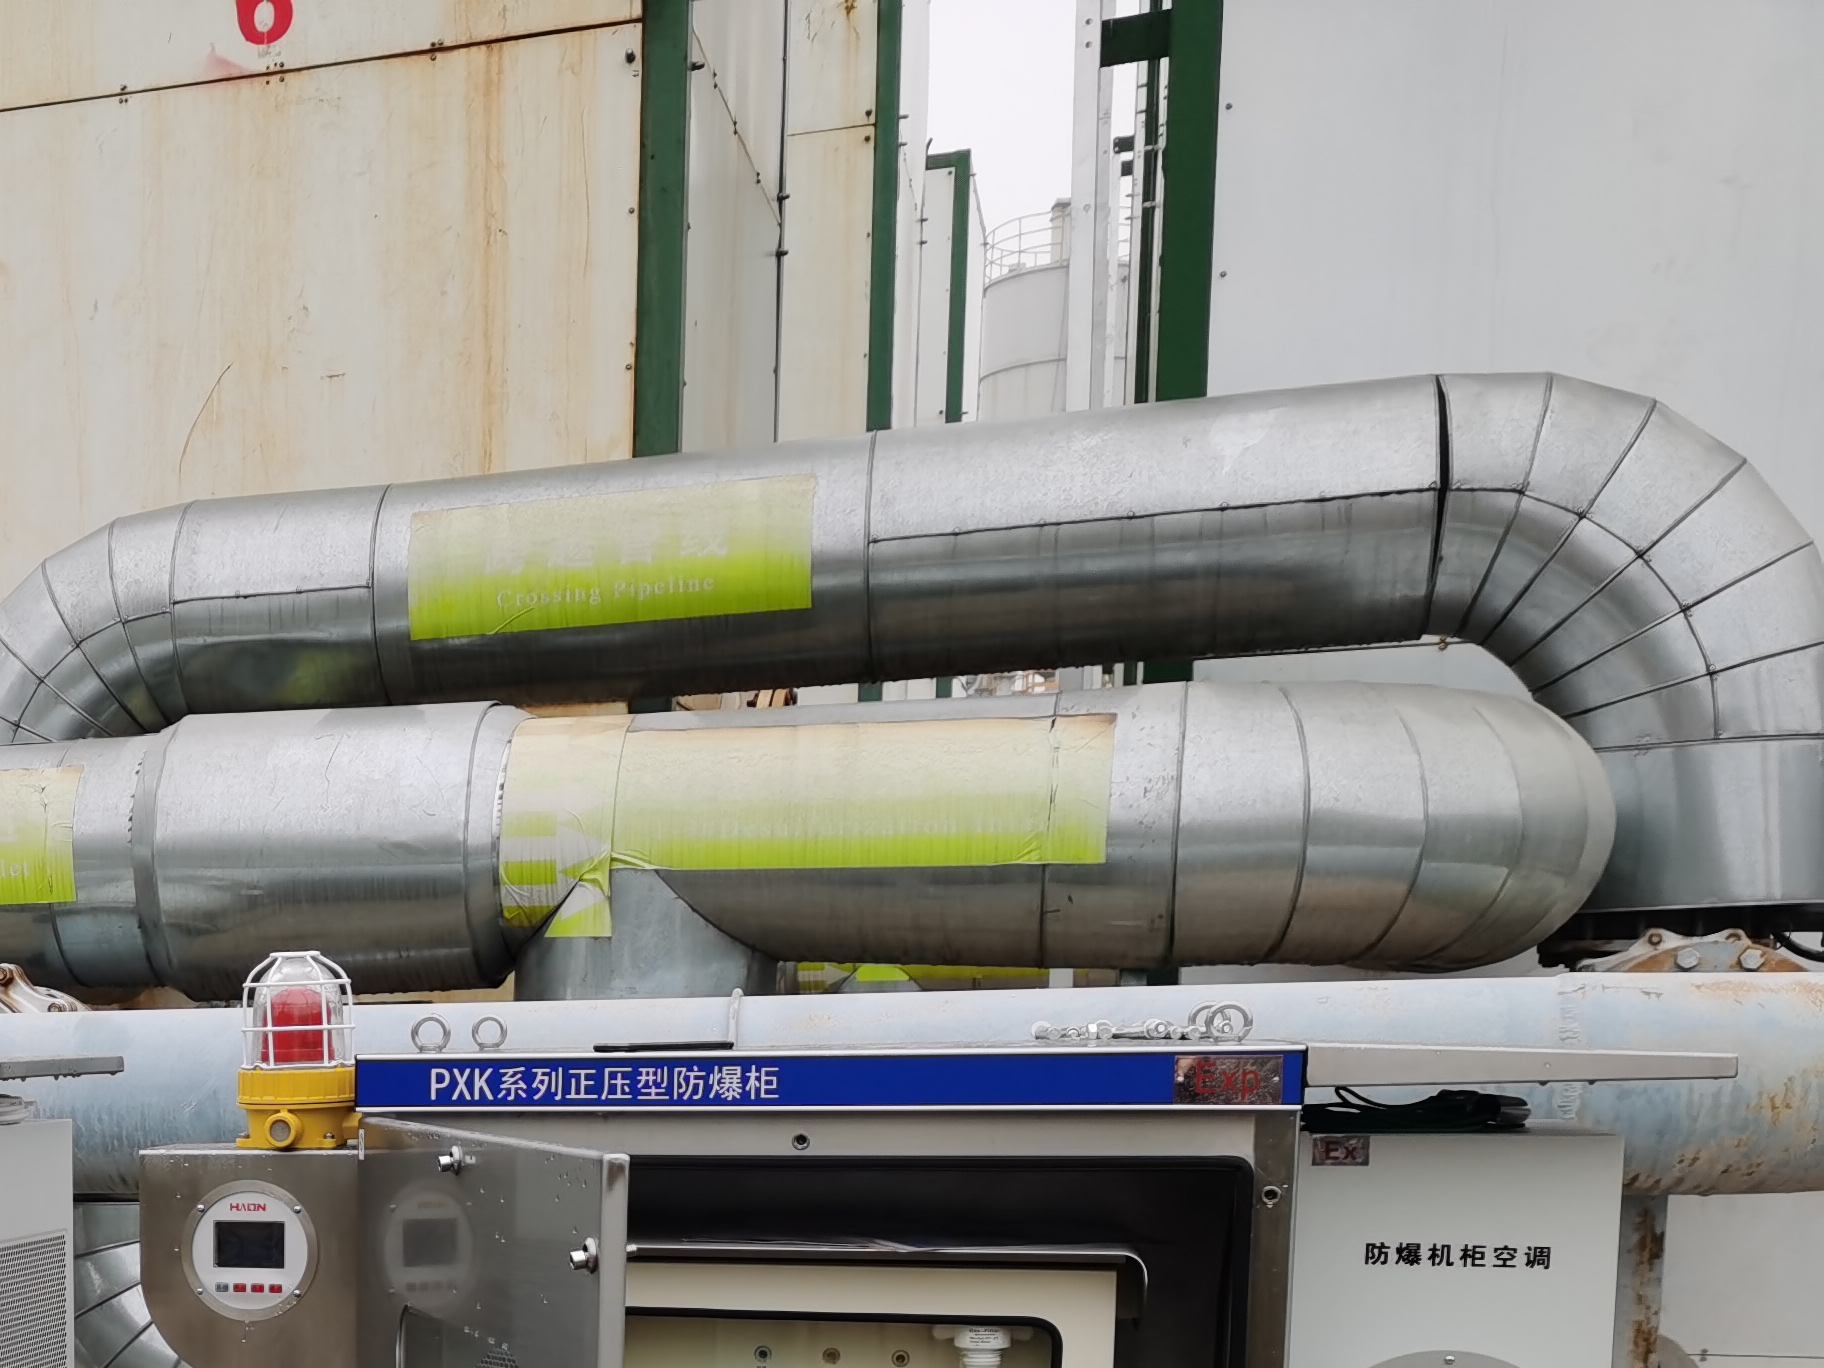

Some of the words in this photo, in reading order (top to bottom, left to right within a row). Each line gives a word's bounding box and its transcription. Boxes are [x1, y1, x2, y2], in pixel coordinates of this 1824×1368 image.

[497, 586, 602, 607] Crossing
[614, 576, 715, 601] Pipeline
[428, 1064, 780, 1104] PXK系列正压型防爆柜
[1195, 1061, 1261, 1101] Exp
[1323, 1140, 1357, 1162] Ex
[1364, 1241, 1552, 1271] 防爆机柜空调
